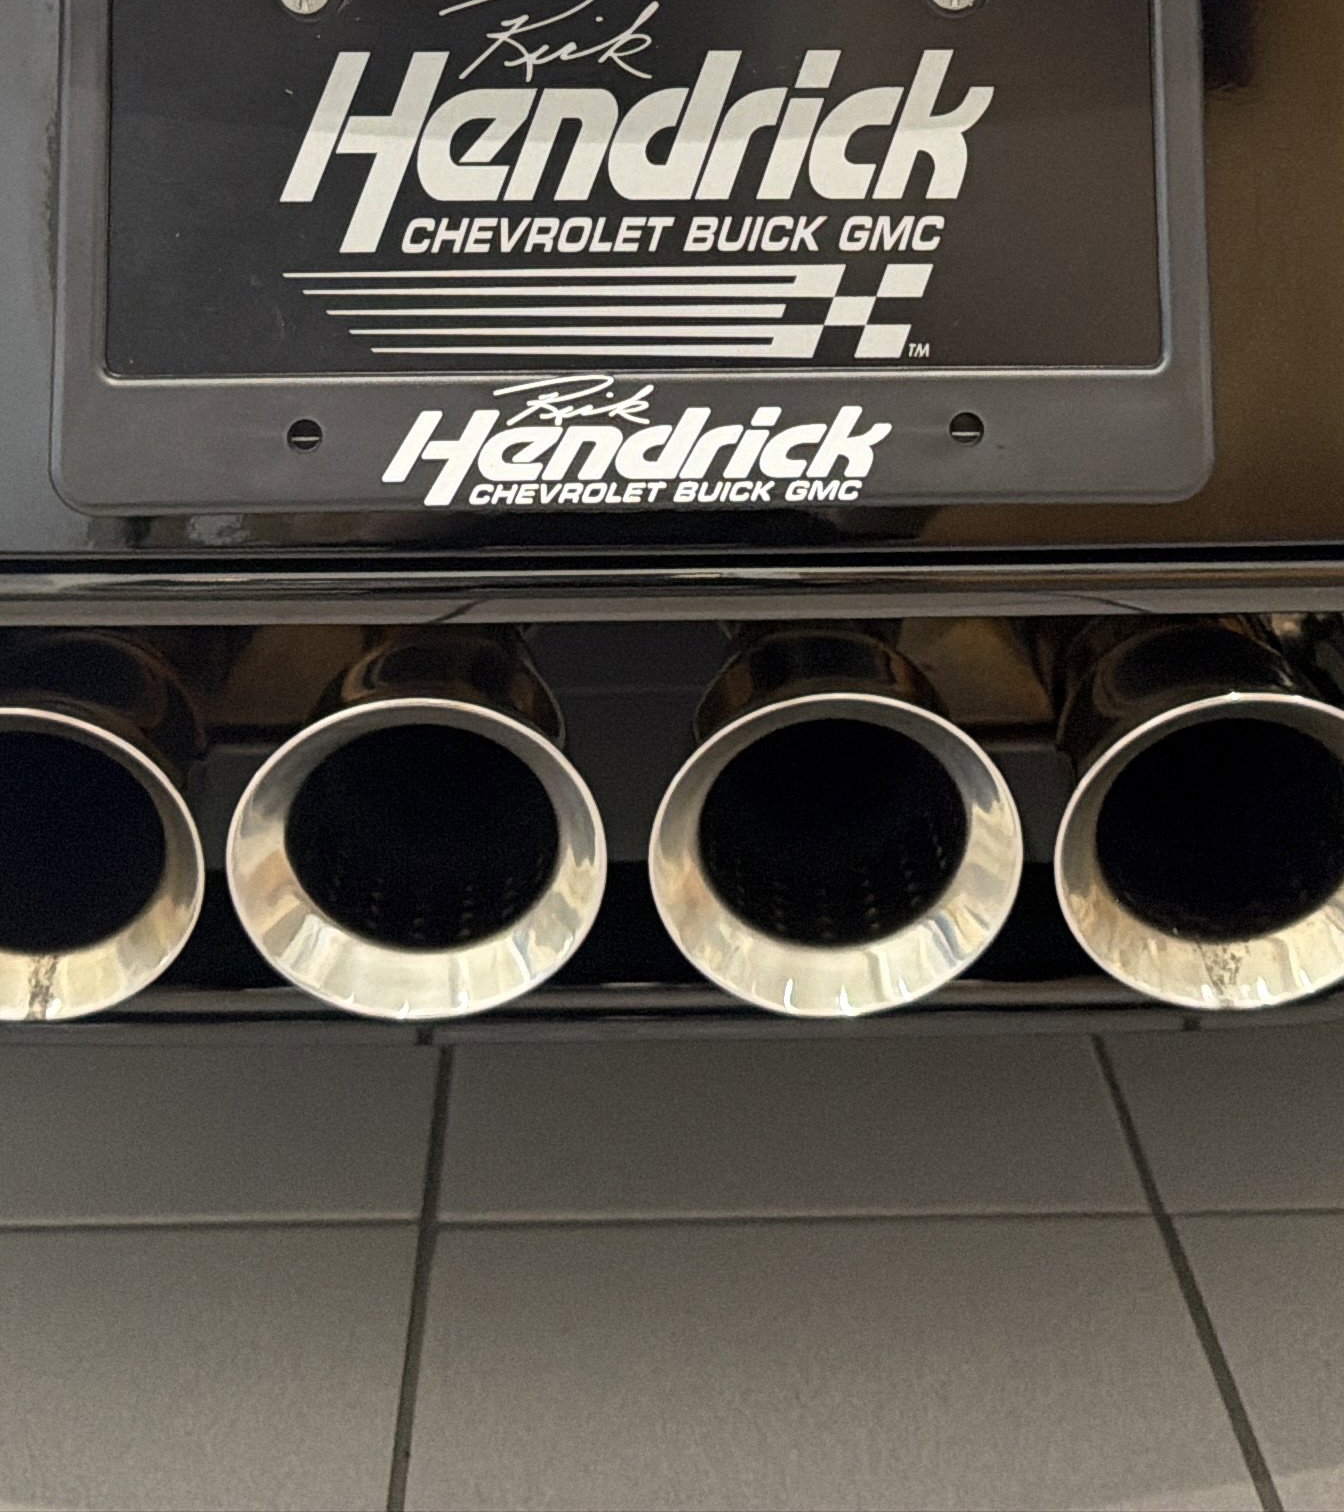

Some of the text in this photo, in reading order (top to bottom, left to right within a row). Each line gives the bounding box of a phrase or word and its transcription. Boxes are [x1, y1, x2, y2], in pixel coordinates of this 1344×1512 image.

[279, 48, 996, 255] Hendrick
[400, 214, 946, 254] CHEVROLET BUICK GMC
[380, 405, 893, 508] Hendrick
[467, 478, 863, 506] CHEVROLET BUICK GMC
